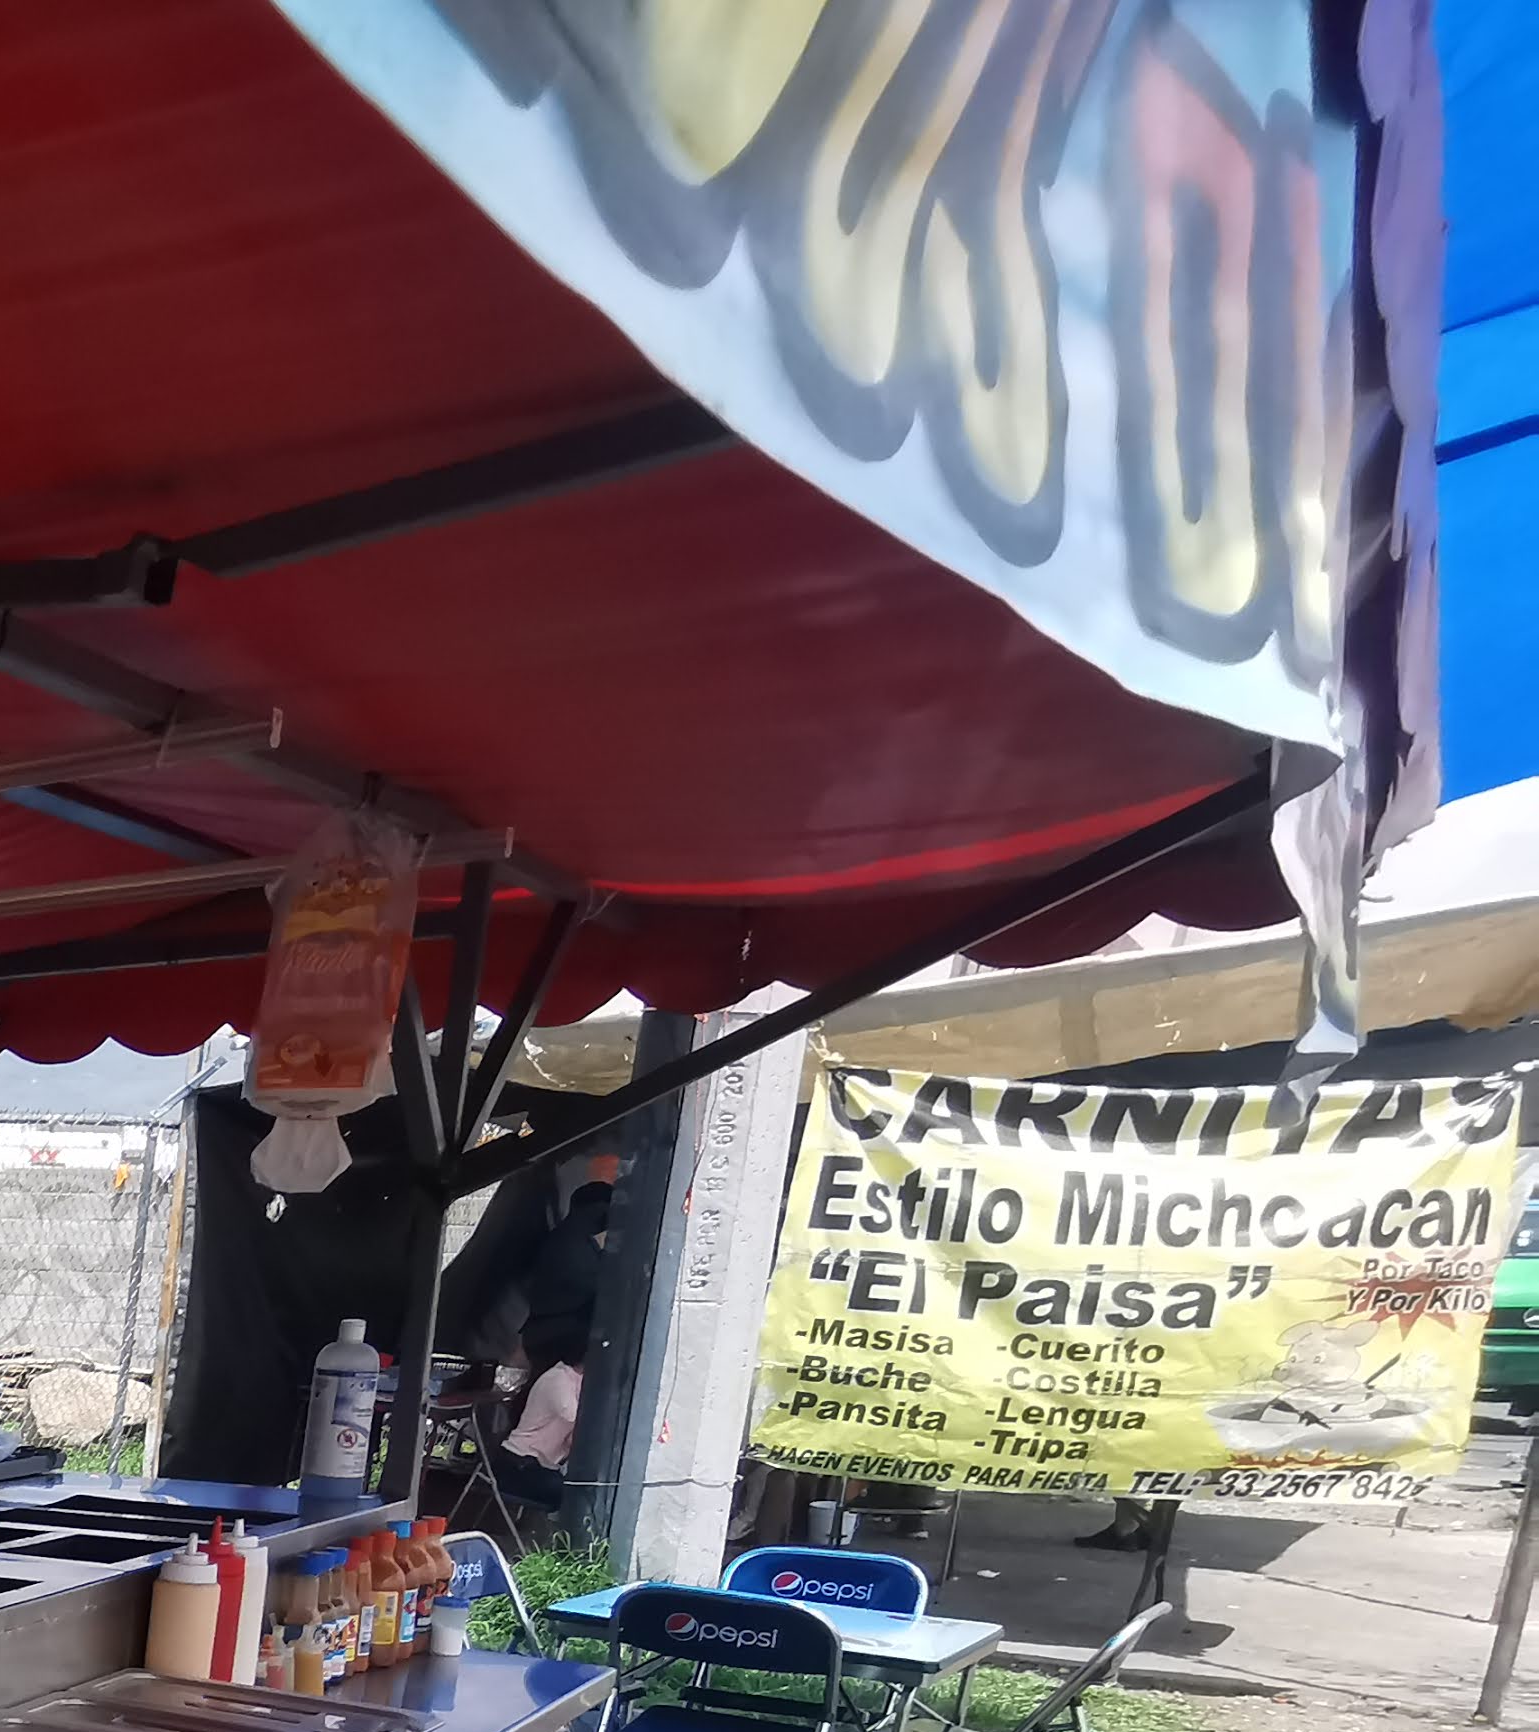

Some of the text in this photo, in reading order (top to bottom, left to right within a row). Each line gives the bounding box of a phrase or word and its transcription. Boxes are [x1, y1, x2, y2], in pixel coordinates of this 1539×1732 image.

[722, 1062, 749, 1098] 201
[808, 1156, 1022, 1244] Estilo
[1363, 1258, 1484, 1280] Por Taco
[1346, 1286, 1485, 1312] Y Por Kilo
[795, 1319, 1166, 1364] -Masisa -Cuerito
[787, 1355, 1162, 1398] -Buche -Costilla
[778, 1391, 1146, 1434] -Pansita -Lengua
[974, 1430, 1090, 1463] -Tripa
[846, 1453, 954, 1482] EVENTOS
[962, 1466, 1024, 1488] PARA
[1029, 1470, 1109, 1492] FIESTA
[1214, 1471, 1256, 1497] 33
[1261, 1472, 1342, 1497] 2567
[802, 1582, 874, 1602] pepsi
[698, 1621, 779, 1649] pepsi
